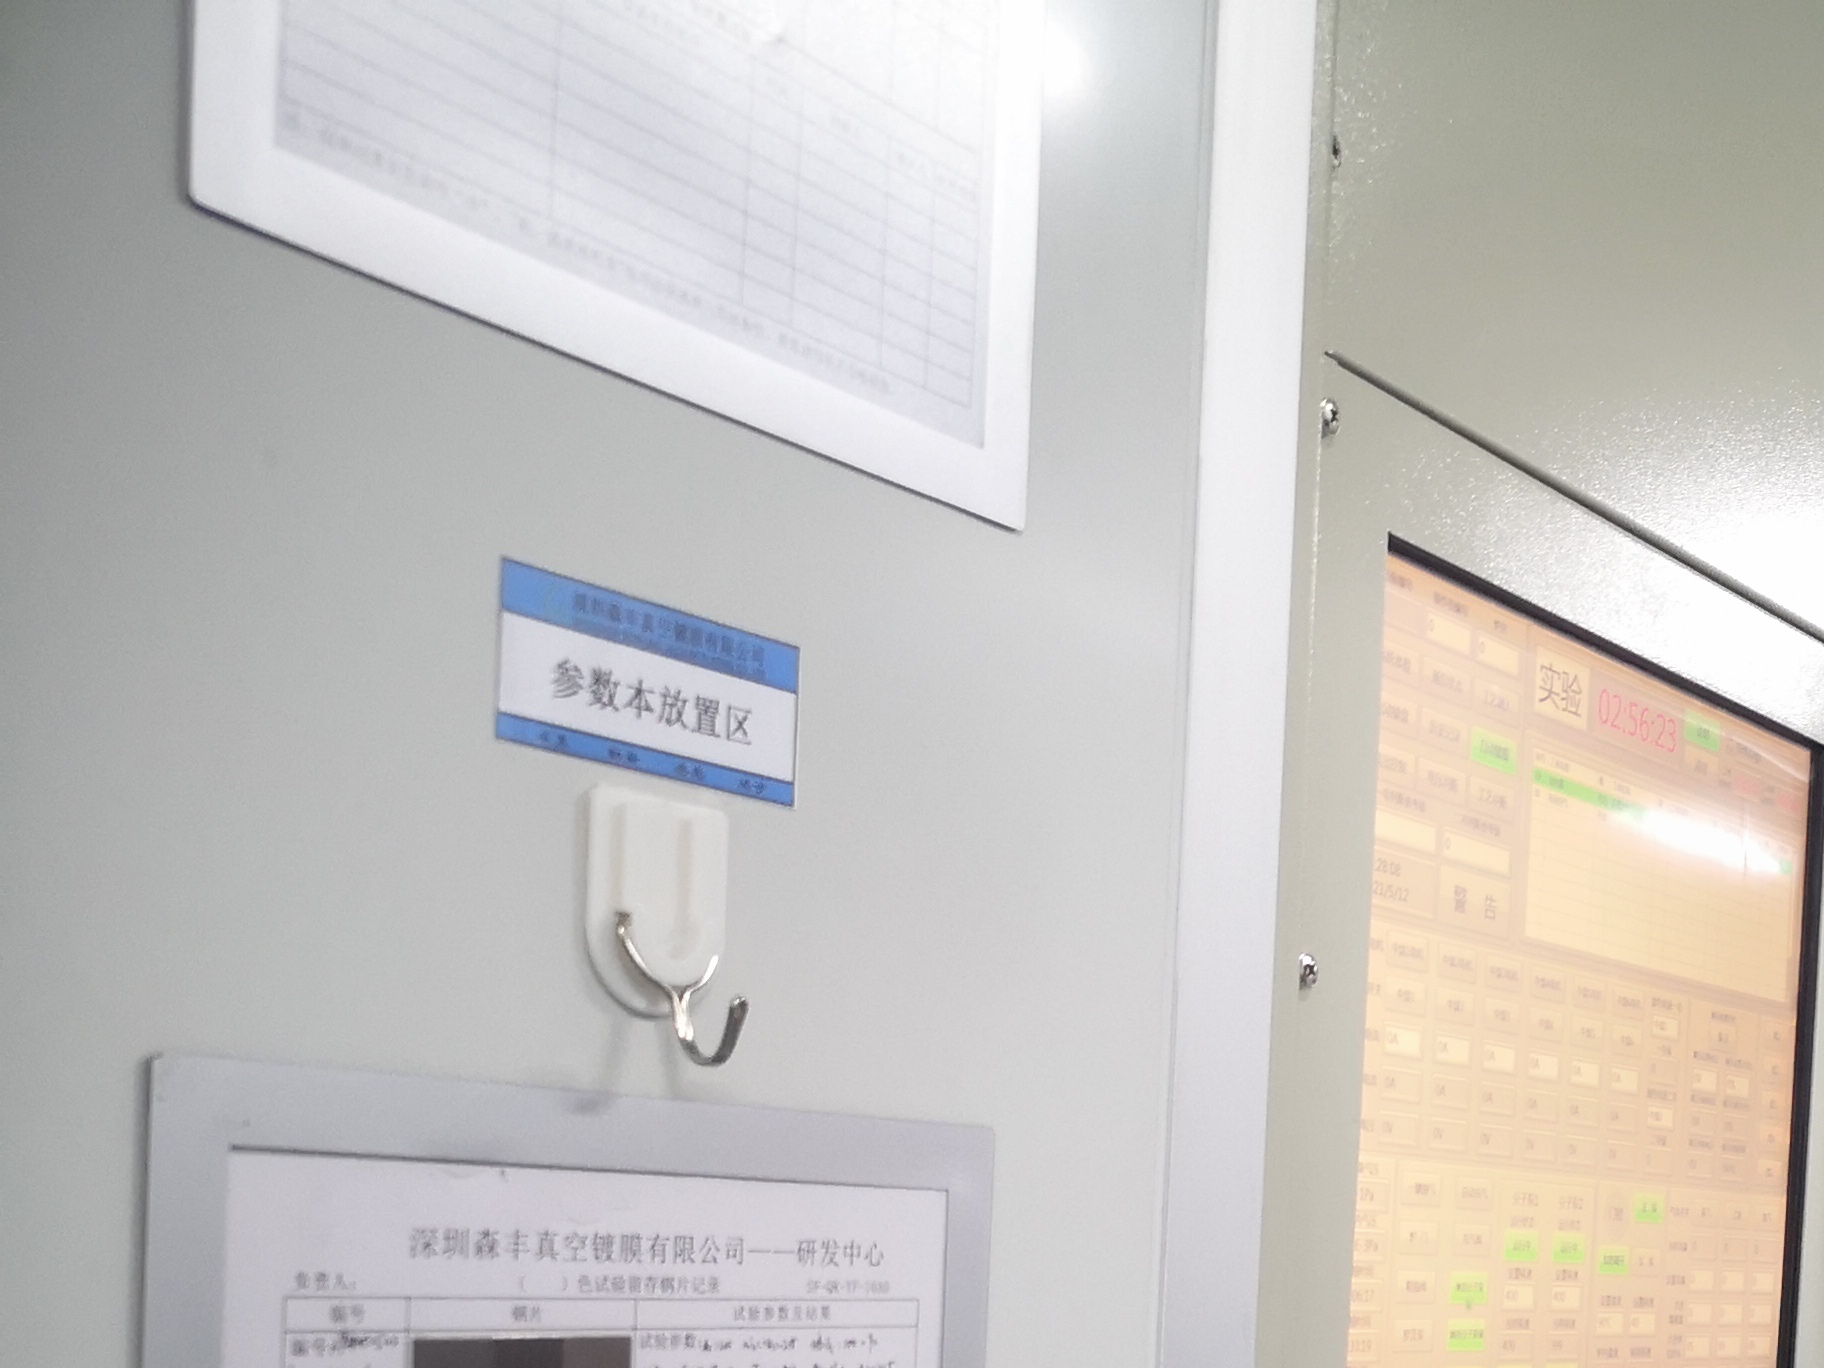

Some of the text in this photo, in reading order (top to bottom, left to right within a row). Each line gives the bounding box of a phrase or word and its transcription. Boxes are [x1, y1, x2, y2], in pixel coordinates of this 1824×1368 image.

[552, 657, 752, 745] 参数本放置区
[1537, 662, 1583, 718] 实验
[1597, 688, 1678, 753] 02:56:23
